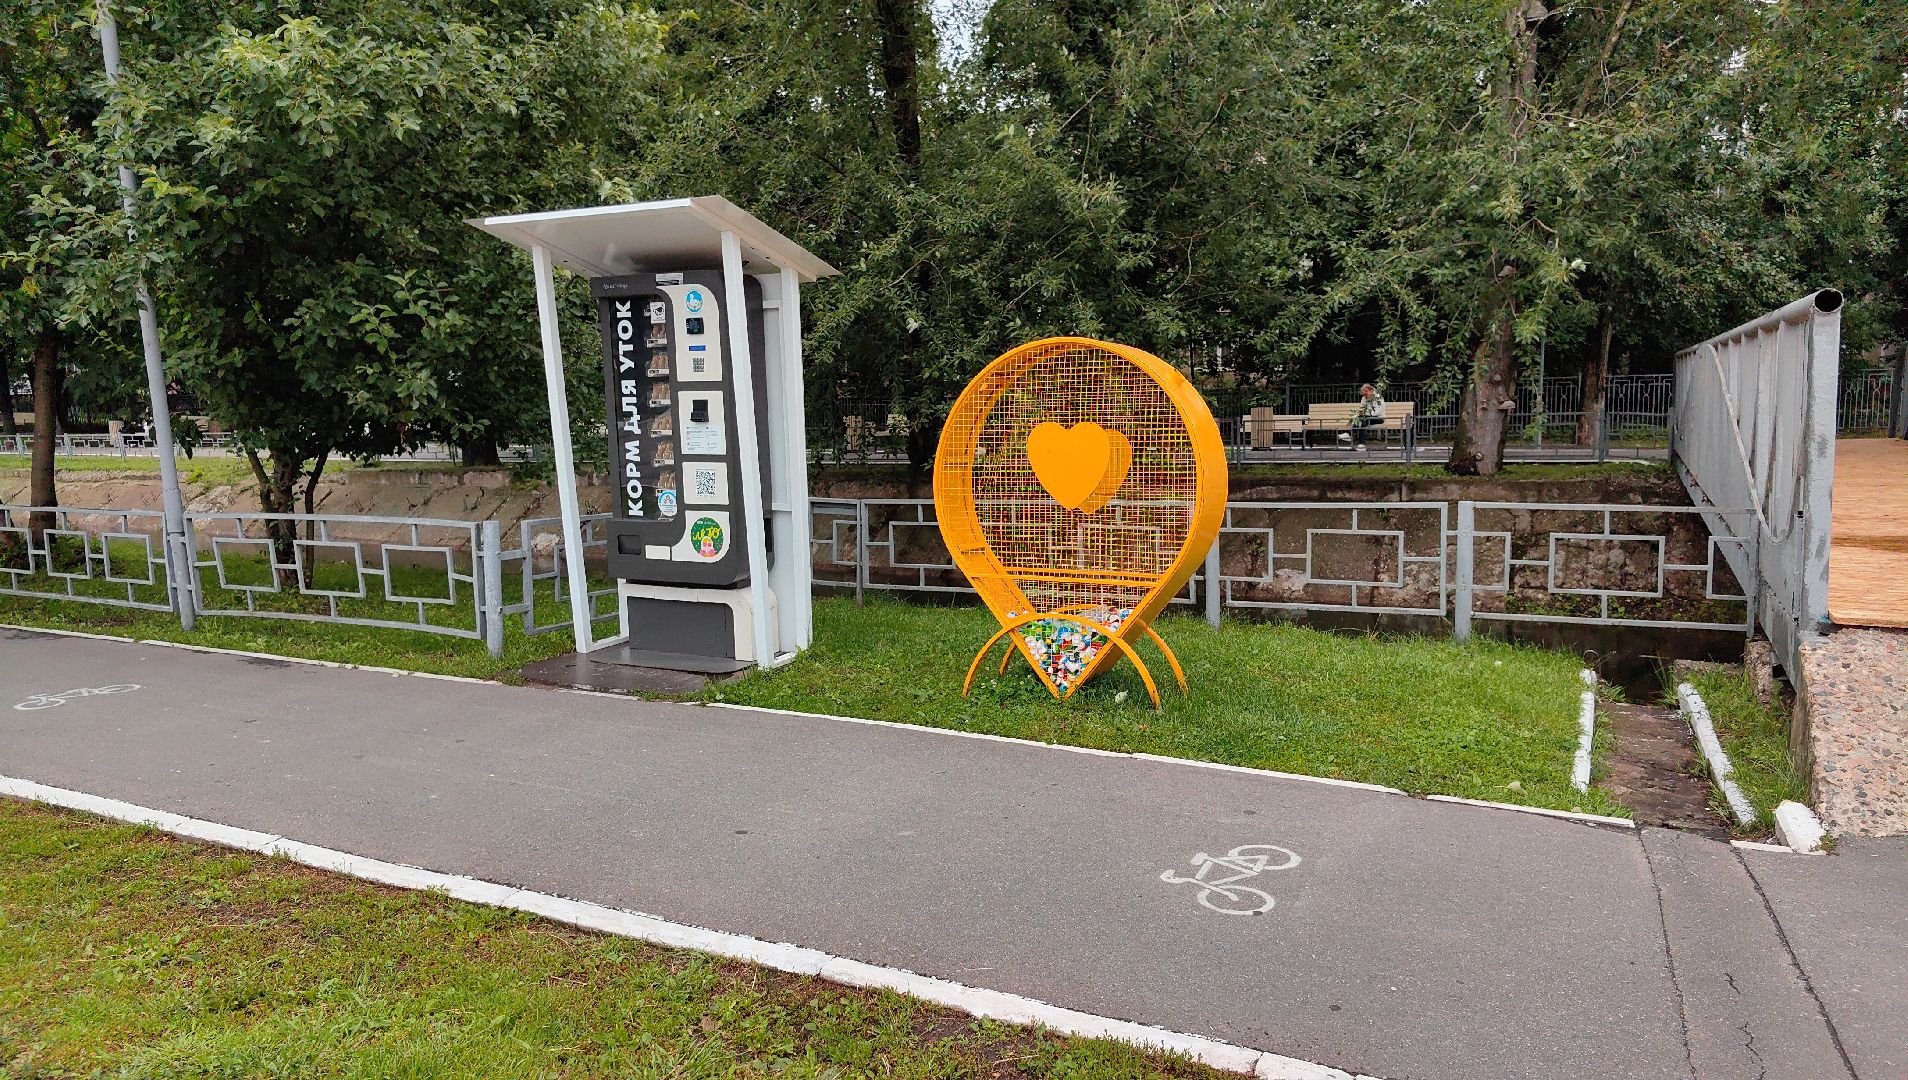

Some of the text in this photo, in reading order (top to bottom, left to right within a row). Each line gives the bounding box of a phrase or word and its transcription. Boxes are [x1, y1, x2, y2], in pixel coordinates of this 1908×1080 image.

[615, 300, 634, 373] УТОК
[621, 379, 641, 434] ДЛЯ
[625, 440, 643, 516] КОРМ
